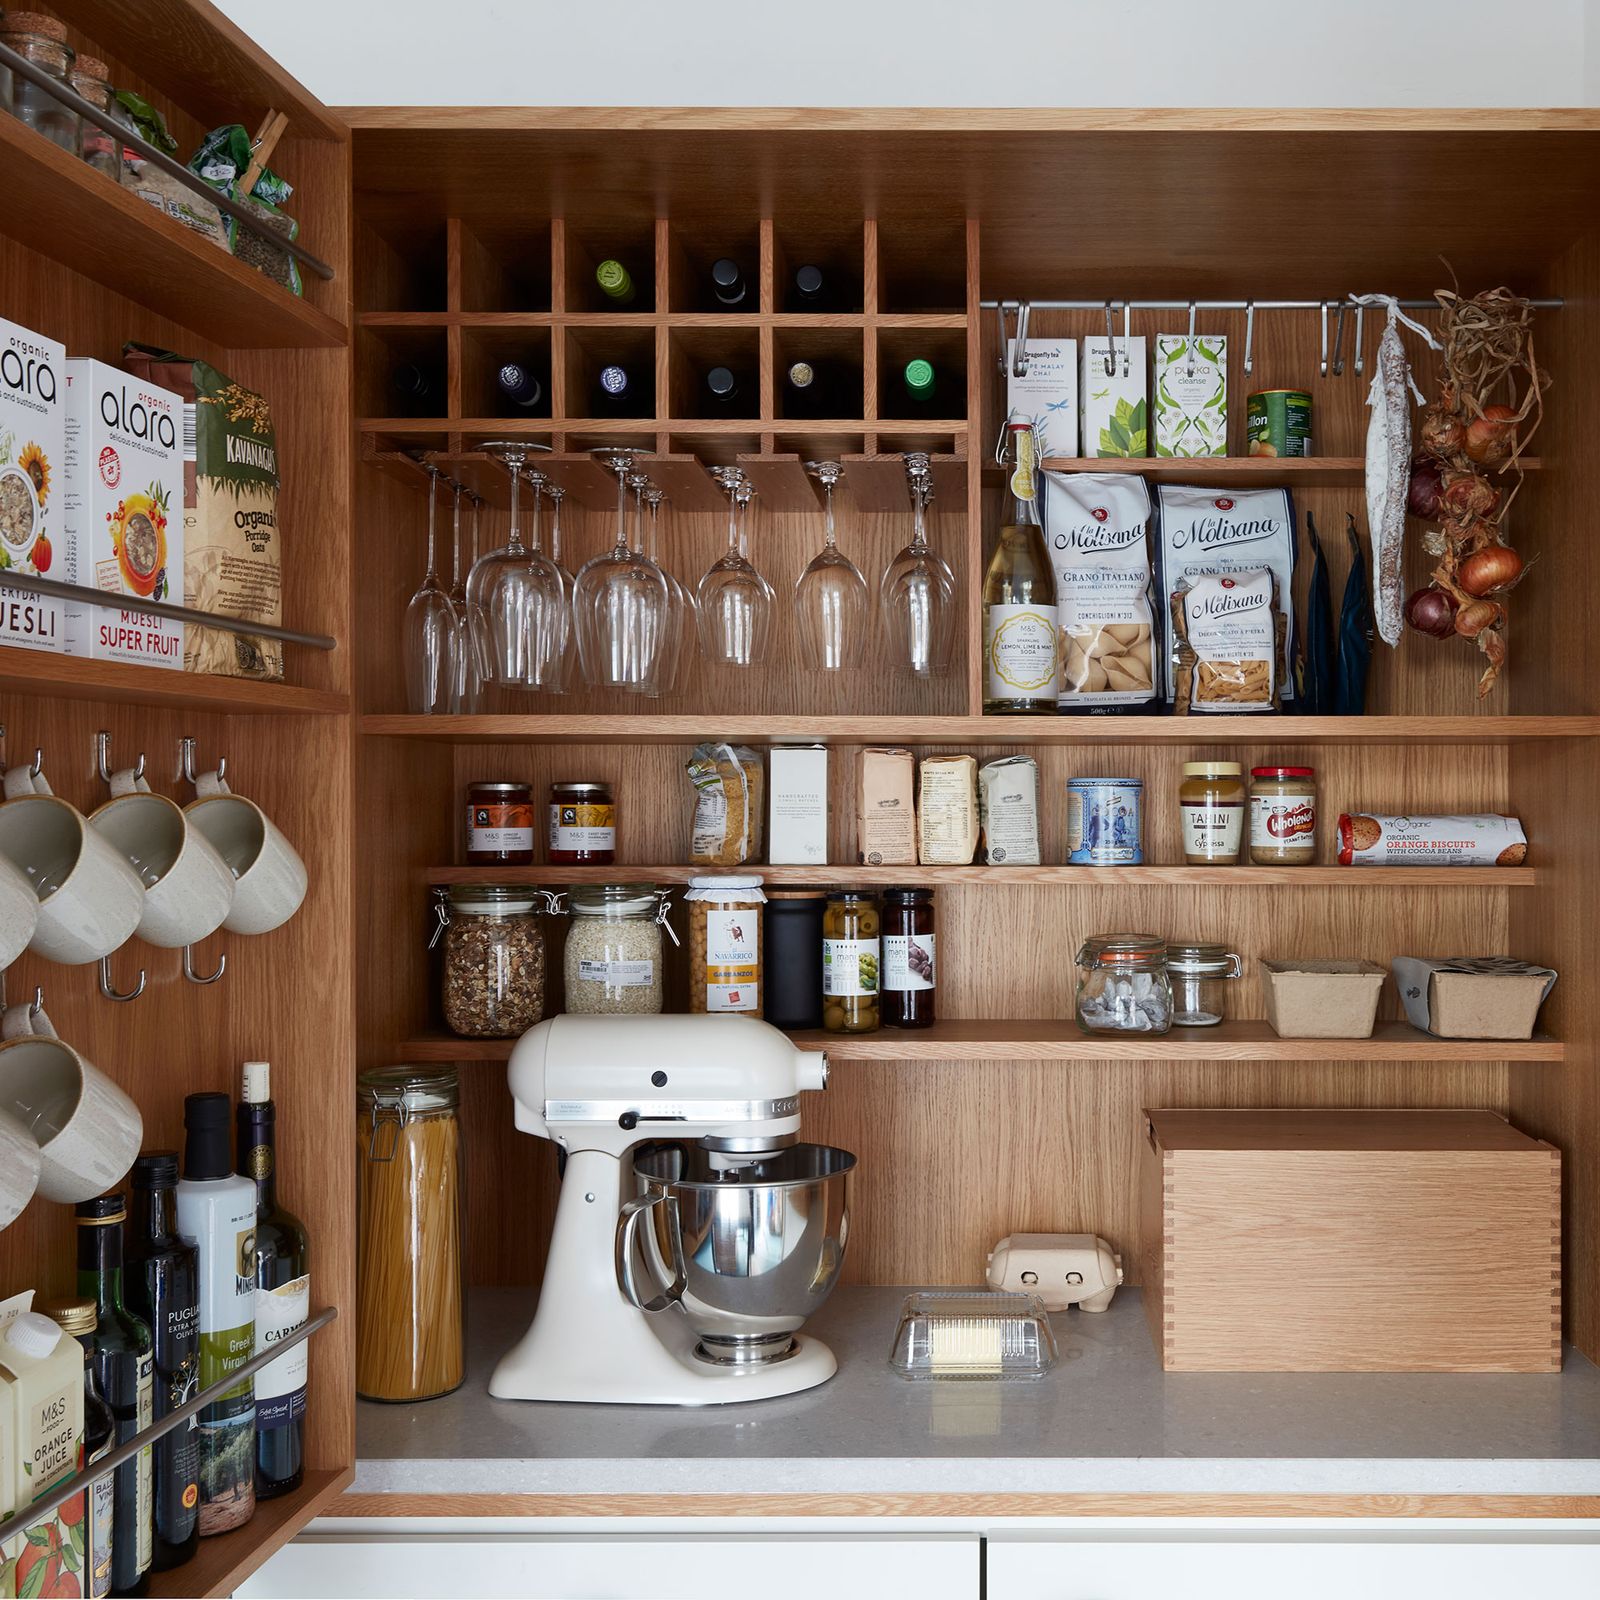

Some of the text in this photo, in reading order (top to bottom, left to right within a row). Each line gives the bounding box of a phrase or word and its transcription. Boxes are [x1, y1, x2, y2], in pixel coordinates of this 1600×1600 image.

[10, 337, 50, 361] organic
[1025, 351, 1050, 360] Dragonfly
[0, 349, 57, 405] ara
[1178, 377, 1207, 385] cleanse
[137, 392, 171, 413] organic
[101, 385, 176, 450] alara
[244, 530, 272, 544] Porridge
[1055, 524, 1147, 554] Molisana
[1172, 517, 1280, 551] Molisana
[1063, 572, 1145, 583] GRANO ITALIANO
[1192, 593, 1268, 620] Molisana
[119, 609, 163, 631] MUESLI
[99, 625, 180, 657] SUPER FRUIT
[484, 832, 500, 840] M&S
[1386, 840, 1476, 849] ORANGE BISCUITS
[714, 951, 753, 961] NAVARRICO
[168, 1323, 190, 1334] EXTRA
[176, 1329, 194, 1341] OLIVE
[41, 1397, 66, 1427] M&S
[46, 1420, 60, 1433] FOOD
[34, 1428, 73, 1462] ORANGE
[41, 1446, 67, 1474] JUICE
